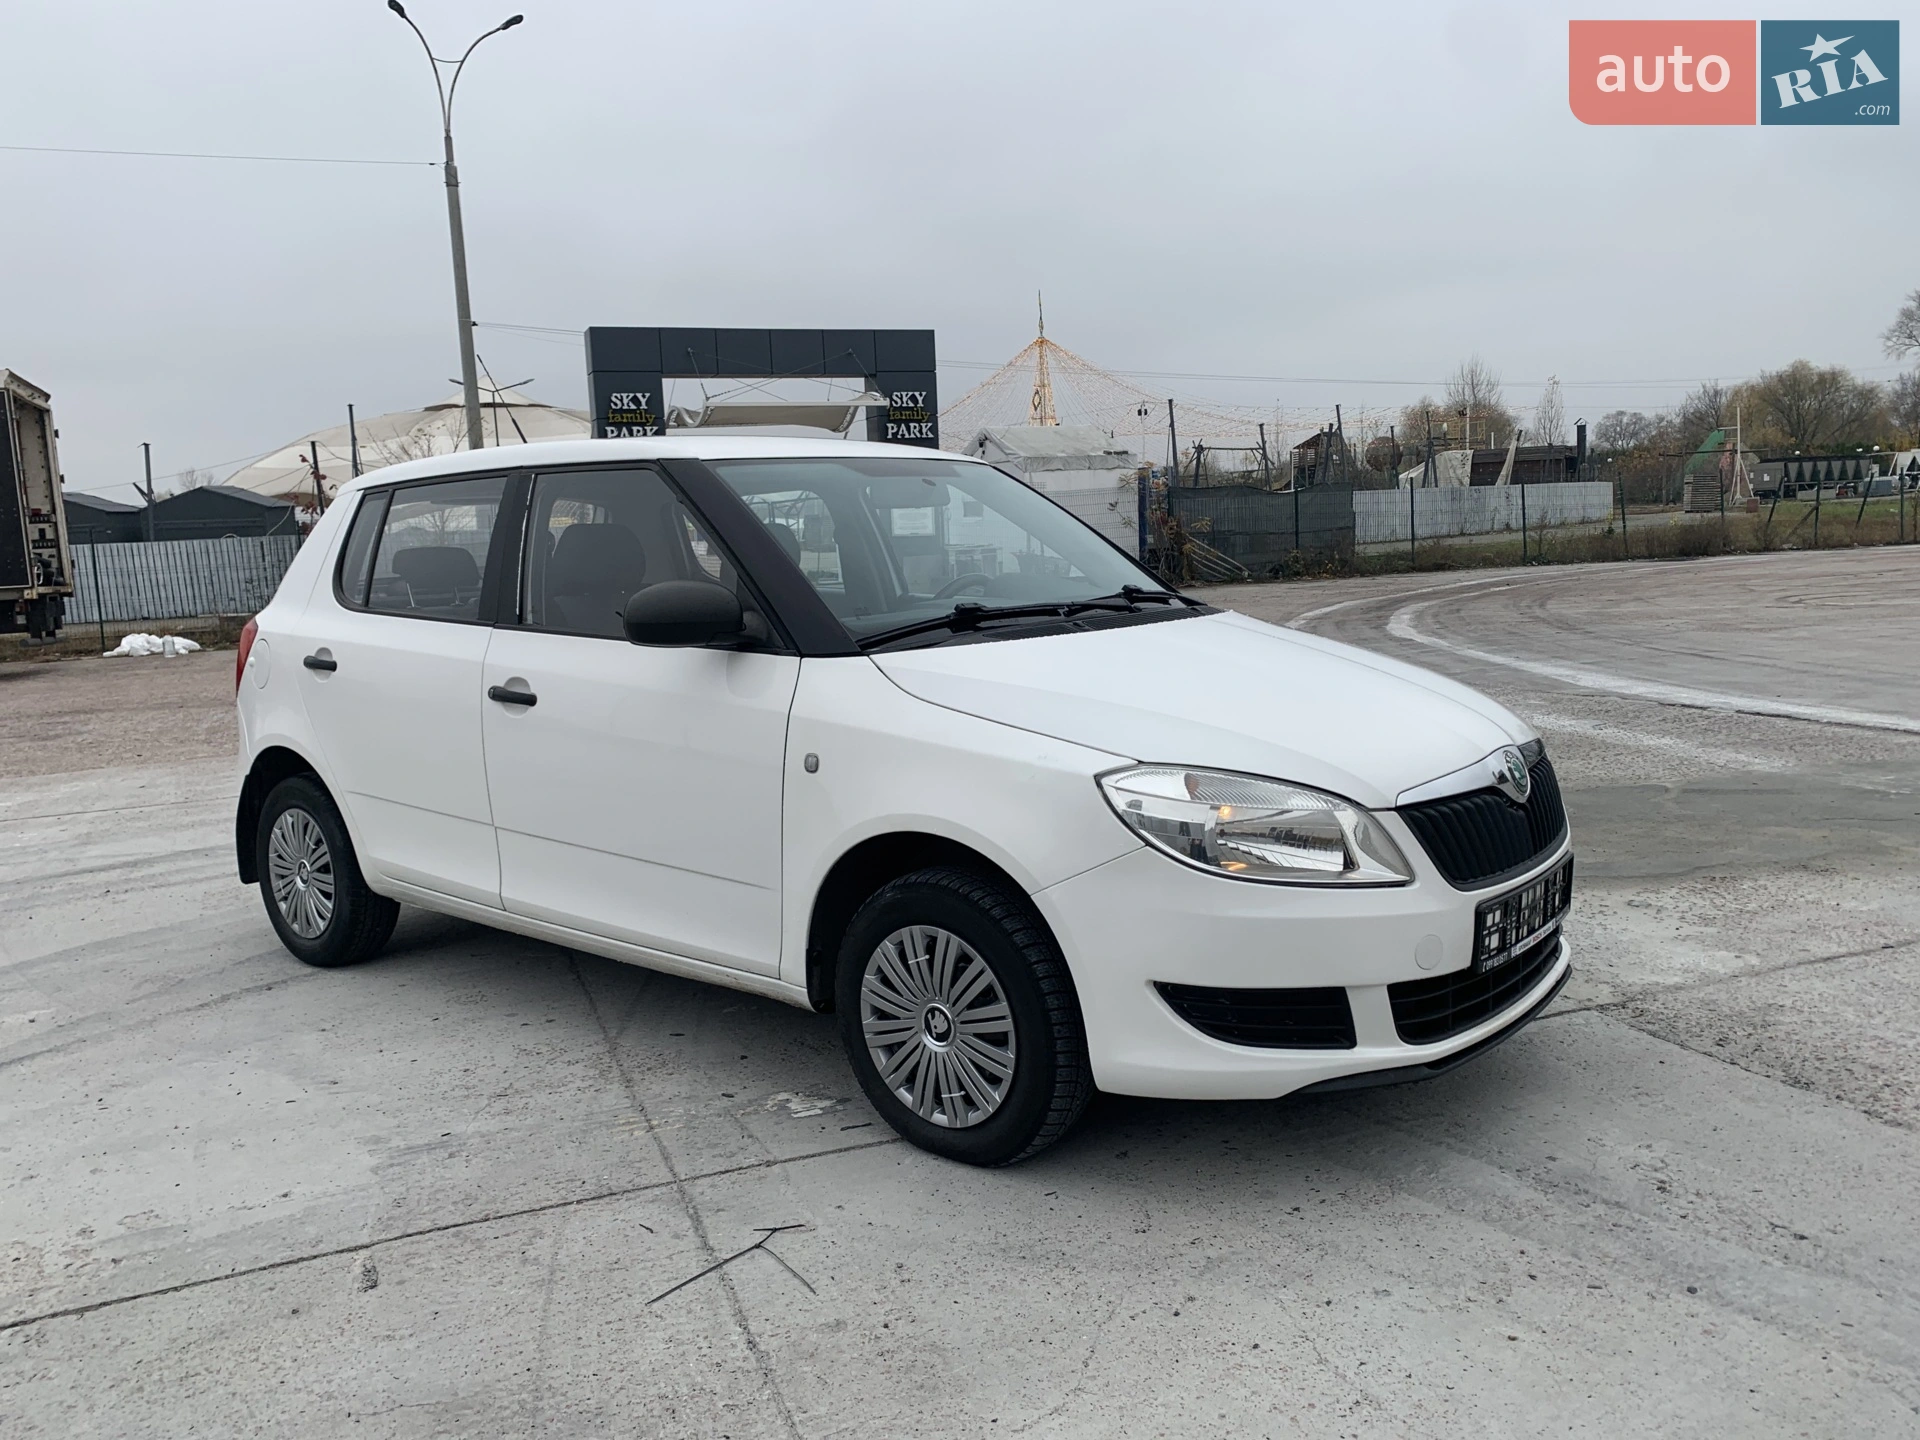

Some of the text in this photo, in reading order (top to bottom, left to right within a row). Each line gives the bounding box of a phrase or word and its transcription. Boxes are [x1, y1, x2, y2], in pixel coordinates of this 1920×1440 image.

[610, 393, 650, 409] SKY
[892, 392, 926, 407] SKY
[608, 409, 655, 425] family
[889, 407, 930, 422] family
[605, 426, 658, 438] PARK
[886, 423, 934, 438] PARK
